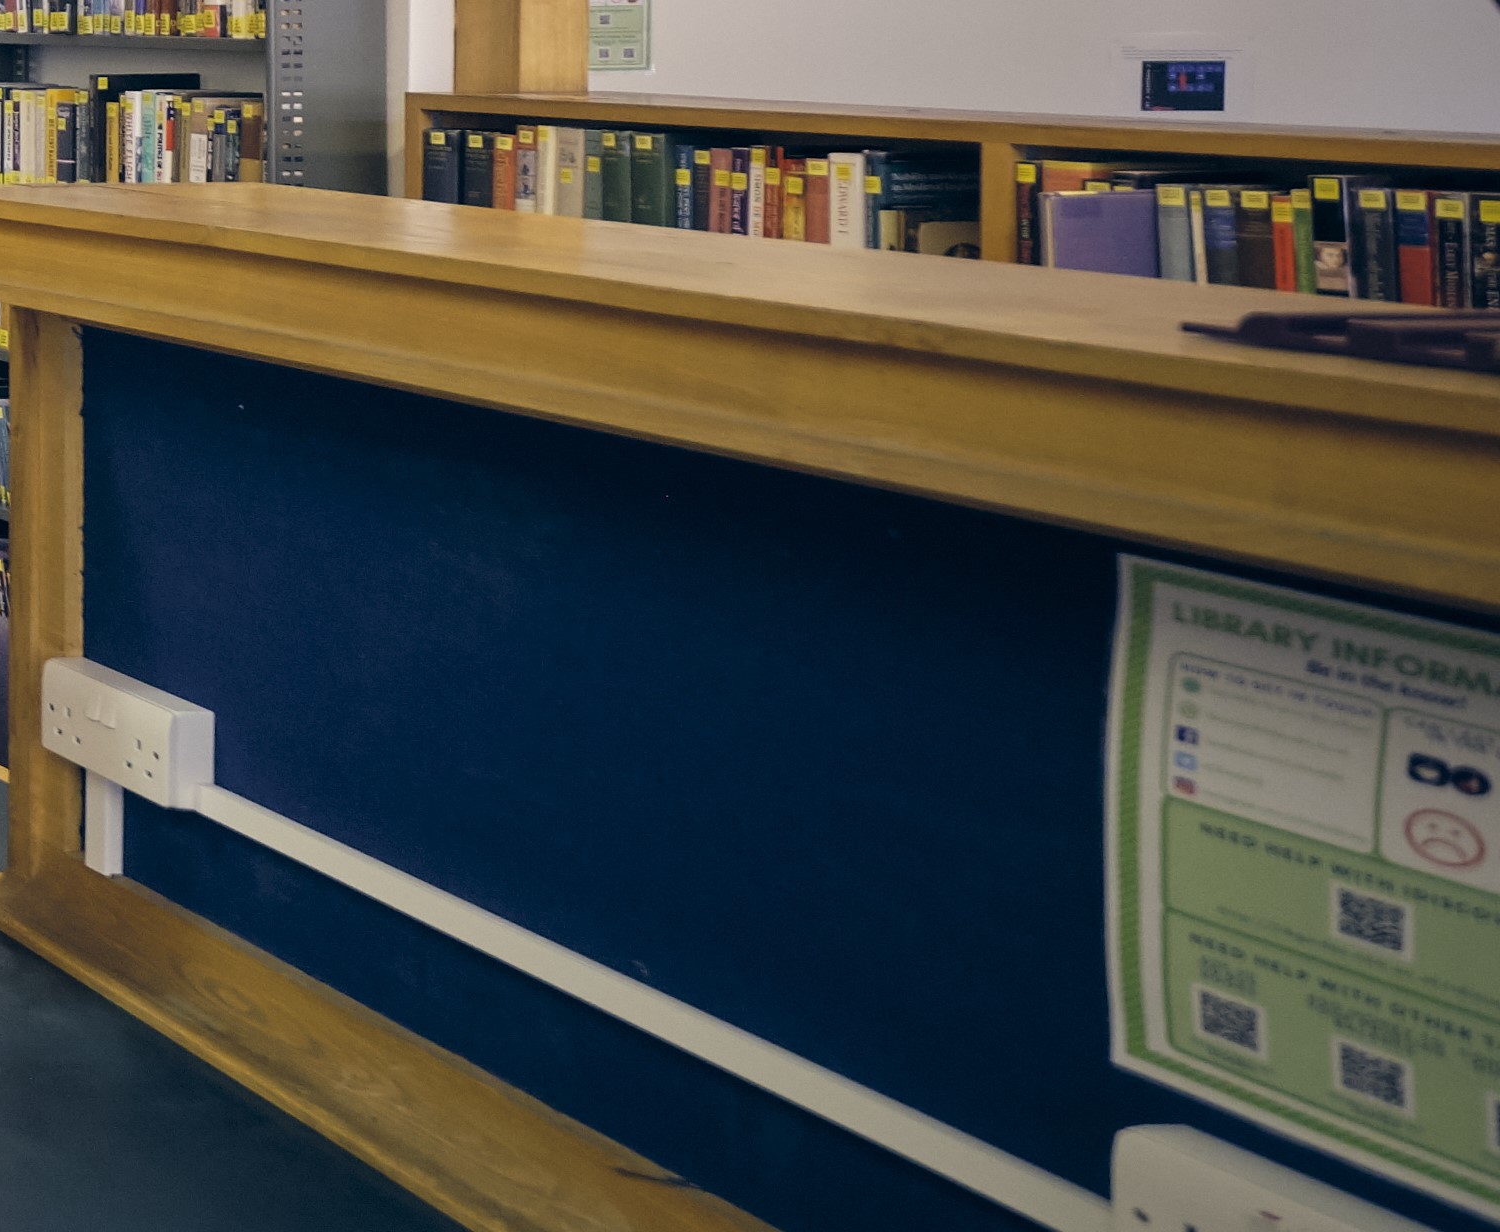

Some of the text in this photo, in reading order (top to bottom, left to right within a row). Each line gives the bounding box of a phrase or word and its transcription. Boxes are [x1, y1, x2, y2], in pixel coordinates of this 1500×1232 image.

[733, 191, 743, 220] leanor
[753, 173, 762, 202] SIMON
[837, 179, 850, 226] EDWARD
[753, 221, 761, 236] MO
[1172, 602, 1500, 696] LIBRARY INFORM
[1200, 821, 1394, 891] NEED HELP WITH
[1189, 931, 1246, 958] NEED
[1253, 953, 1310, 980] HELP
[1317, 977, 1381, 1005] WITH
